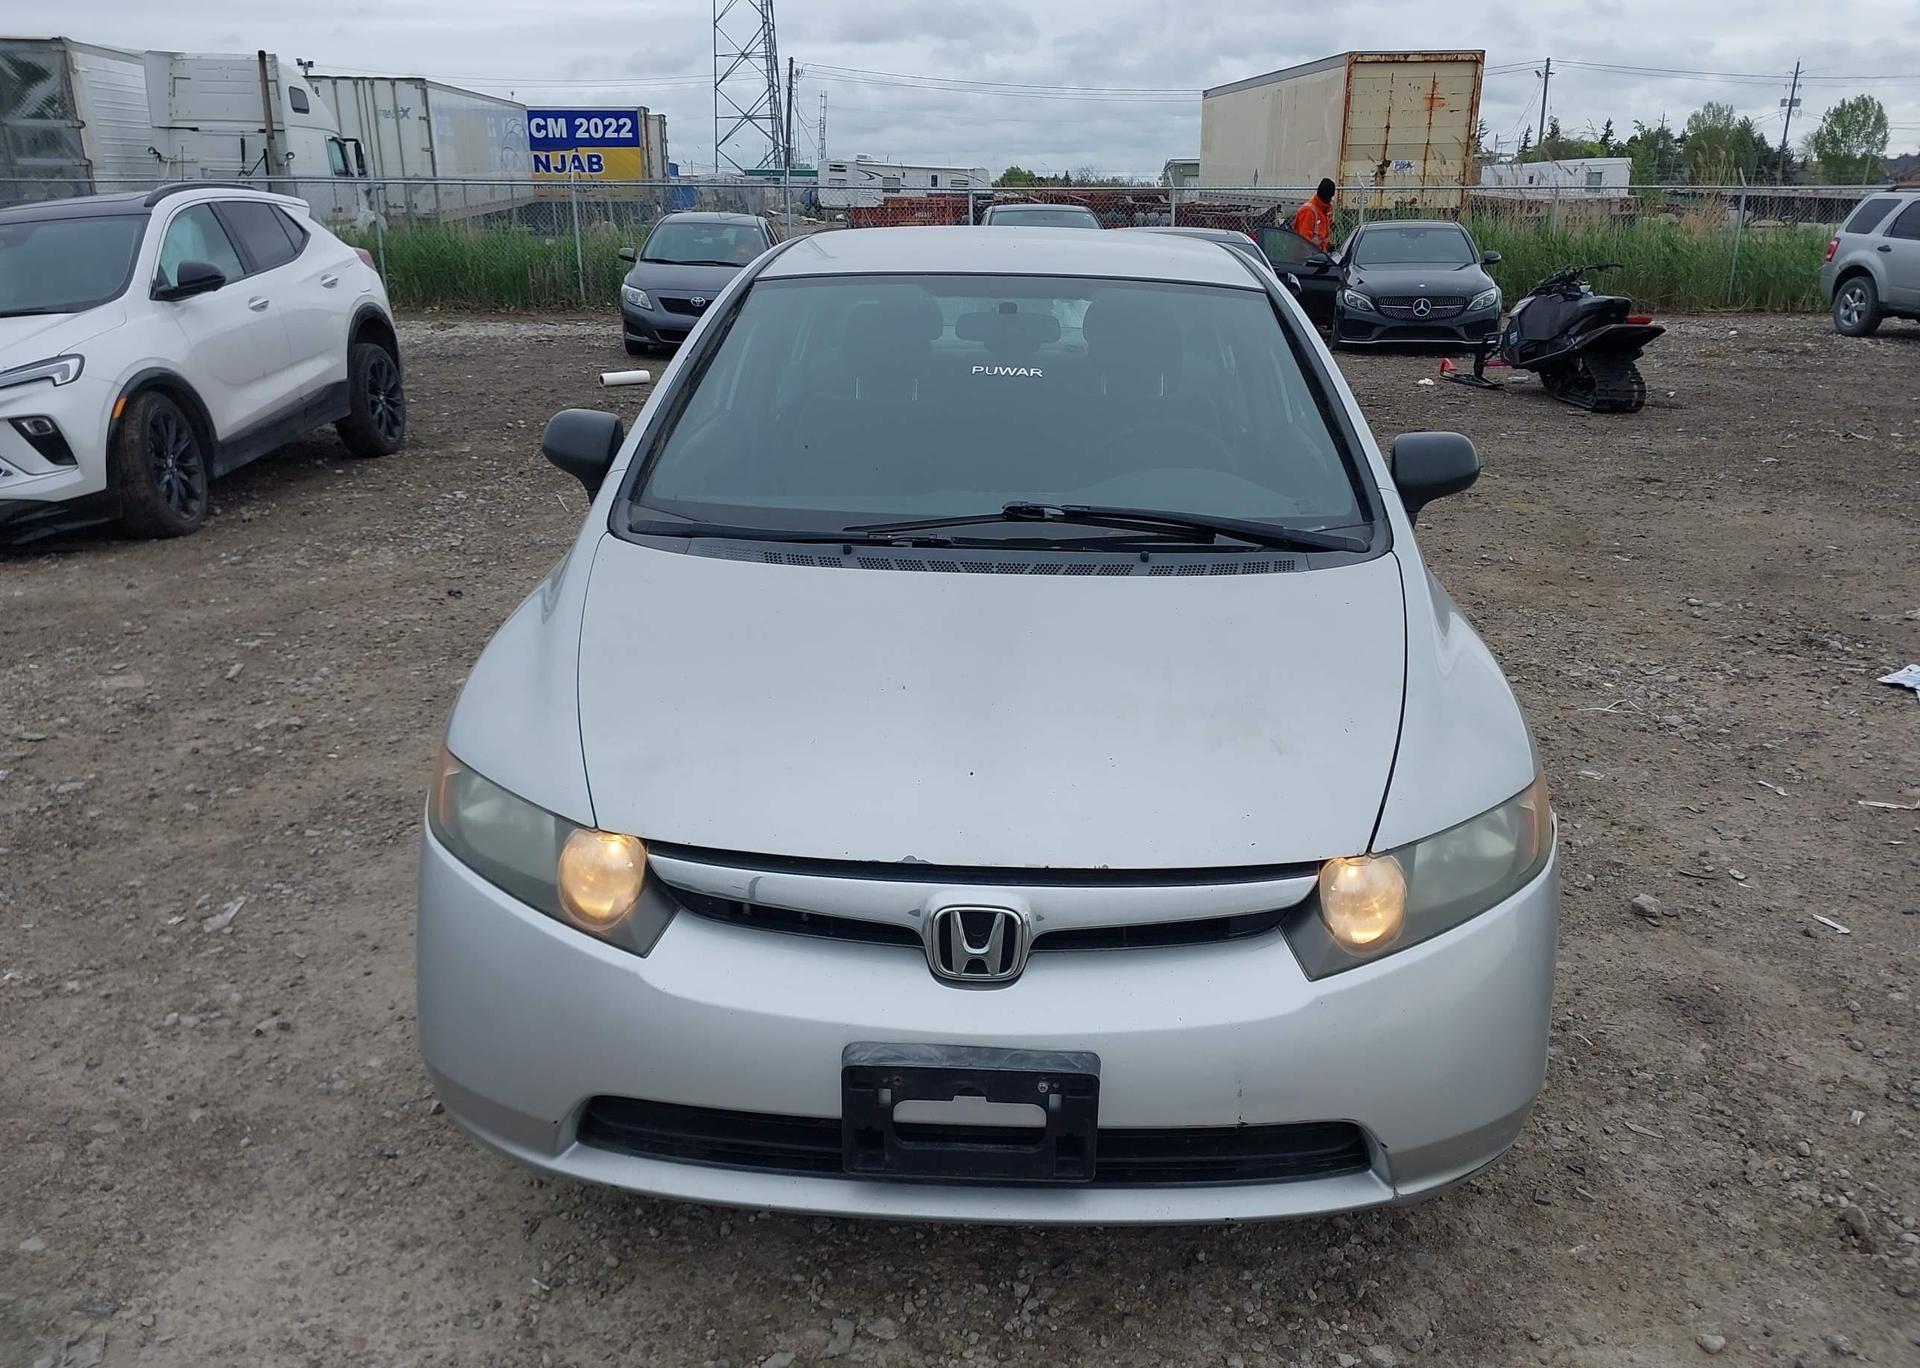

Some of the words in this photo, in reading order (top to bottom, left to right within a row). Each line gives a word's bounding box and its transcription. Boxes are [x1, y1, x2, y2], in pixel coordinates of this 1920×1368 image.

[529, 117, 568, 138] CM
[574, 117, 633, 138] 2022
[532, 153, 605, 174] NJAB
[971, 365, 1043, 377] PUWAR
